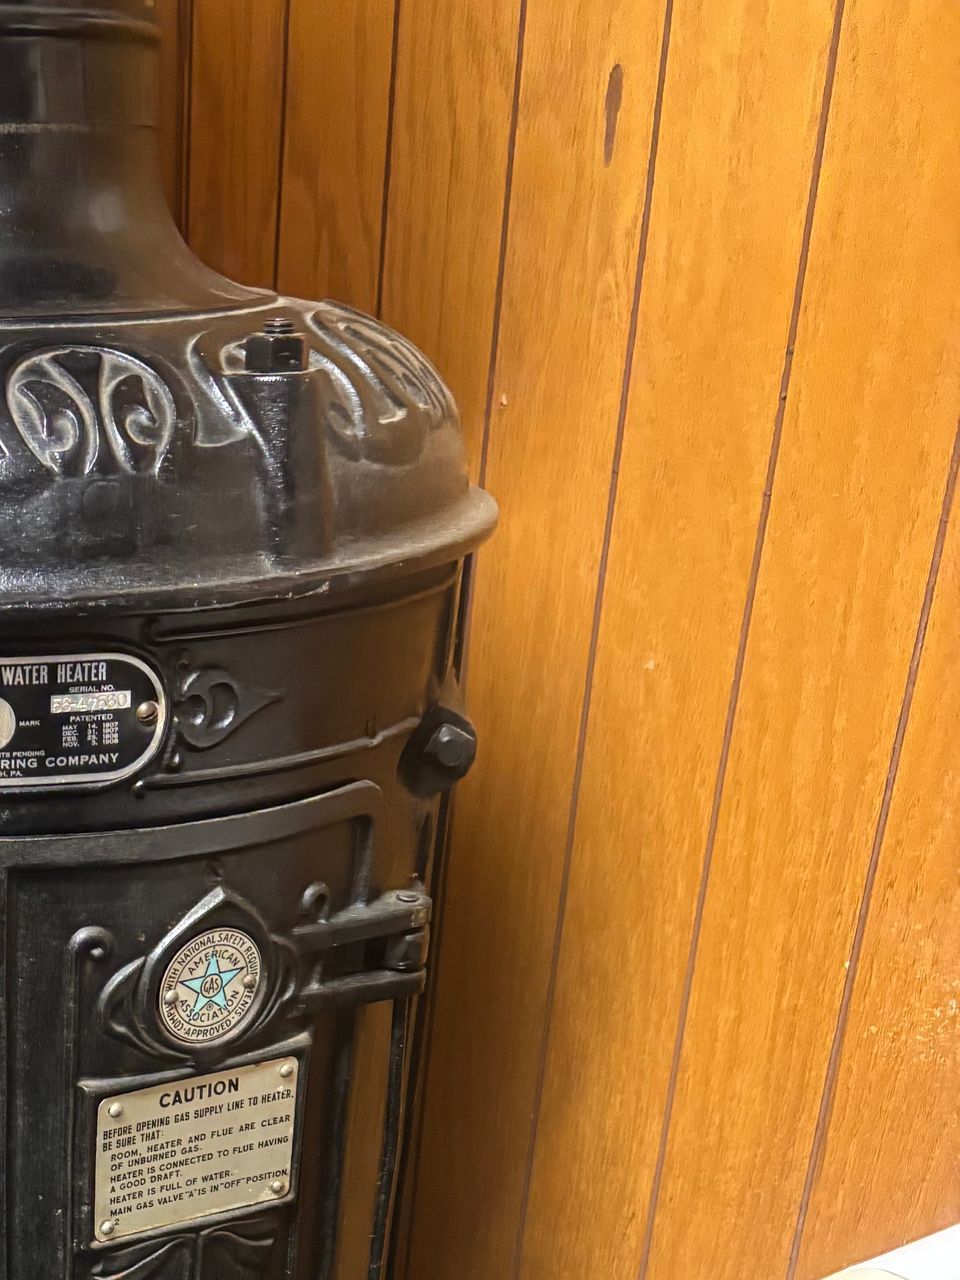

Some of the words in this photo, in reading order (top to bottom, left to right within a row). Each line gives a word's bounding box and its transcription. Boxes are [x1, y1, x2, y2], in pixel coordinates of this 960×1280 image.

[1, 665, 48, 685] WATER
[57, 662, 107, 683] HEATER
[70, 714, 113, 722] PATENTED
[45, 753, 119, 767] COMPANY
[166, 968, 179, 992] WITH
[177, 936, 216, 966] NATIONAL
[218, 933, 246, 948] SAFETY
[188, 950, 240, 975] AMERICAN
[203, 977, 219, 994] GAS
[180, 990, 239, 1023] ASSOCIATION
[184, 1018, 232, 1038] APPROVED
[159, 1076, 239, 1110] CAUTION
[103, 1125, 132, 1140] BEFORE
[136, 1116, 170, 1133] OPENING
[174, 1112, 190, 1124] GAS
[194, 1104, 224, 1119] SUPPLY
[227, 1099, 244, 1112] LINE
[248, 1097, 258, 1107] TO
[103, 1142, 112, 1152] BE
[116, 1136, 136, 1149] SURE
[141, 1129, 164, 1143] THAT:
[111, 1148, 142, 1163] ROOM,
[147, 1138, 183, 1154] HEATER
[188, 1133, 206, 1144] AND
[211, 1127, 233, 1139] FLUE
[239, 1122, 256, 1133] ARE
[261, 1114, 291, 1128] CLEAR
[110, 1169, 144, 1184] HEATER
[147, 1166, 156, 1175] IS
[159, 1152, 214, 1173] CONNECTED
[217, 1149, 229, 1158] TO
[232, 1143, 255, 1155] FLUE
[258, 1135, 289, 1149] HAVING
[111, 1162, 123, 1172] OF
[128, 1149, 177, 1168] UNBURNED
[181, 1143, 202, 1155] GAS.
[110, 1185, 116, 1194] A
[120, 1178, 146, 1191] GOOD
[150, 1169, 183, 1184] DRAFT.
[110, 1190, 144, 1205] HEATER
[147, 1187, 156, 1196] IS
[160, 1181, 182, 1193] FULL
[186, 1177, 197, 1187] OF
[202, 1169, 233, 1183] WATER.
[110, 1205, 132, 1217] MAIN
[136, 1200, 154, 1211] GAS
[157, 1192, 184, 1206] VALVE
[198, 1187, 207, 1196] IS
[210, 1184, 219, 1193] IN
[114, 1218, 120, 1226] 2
